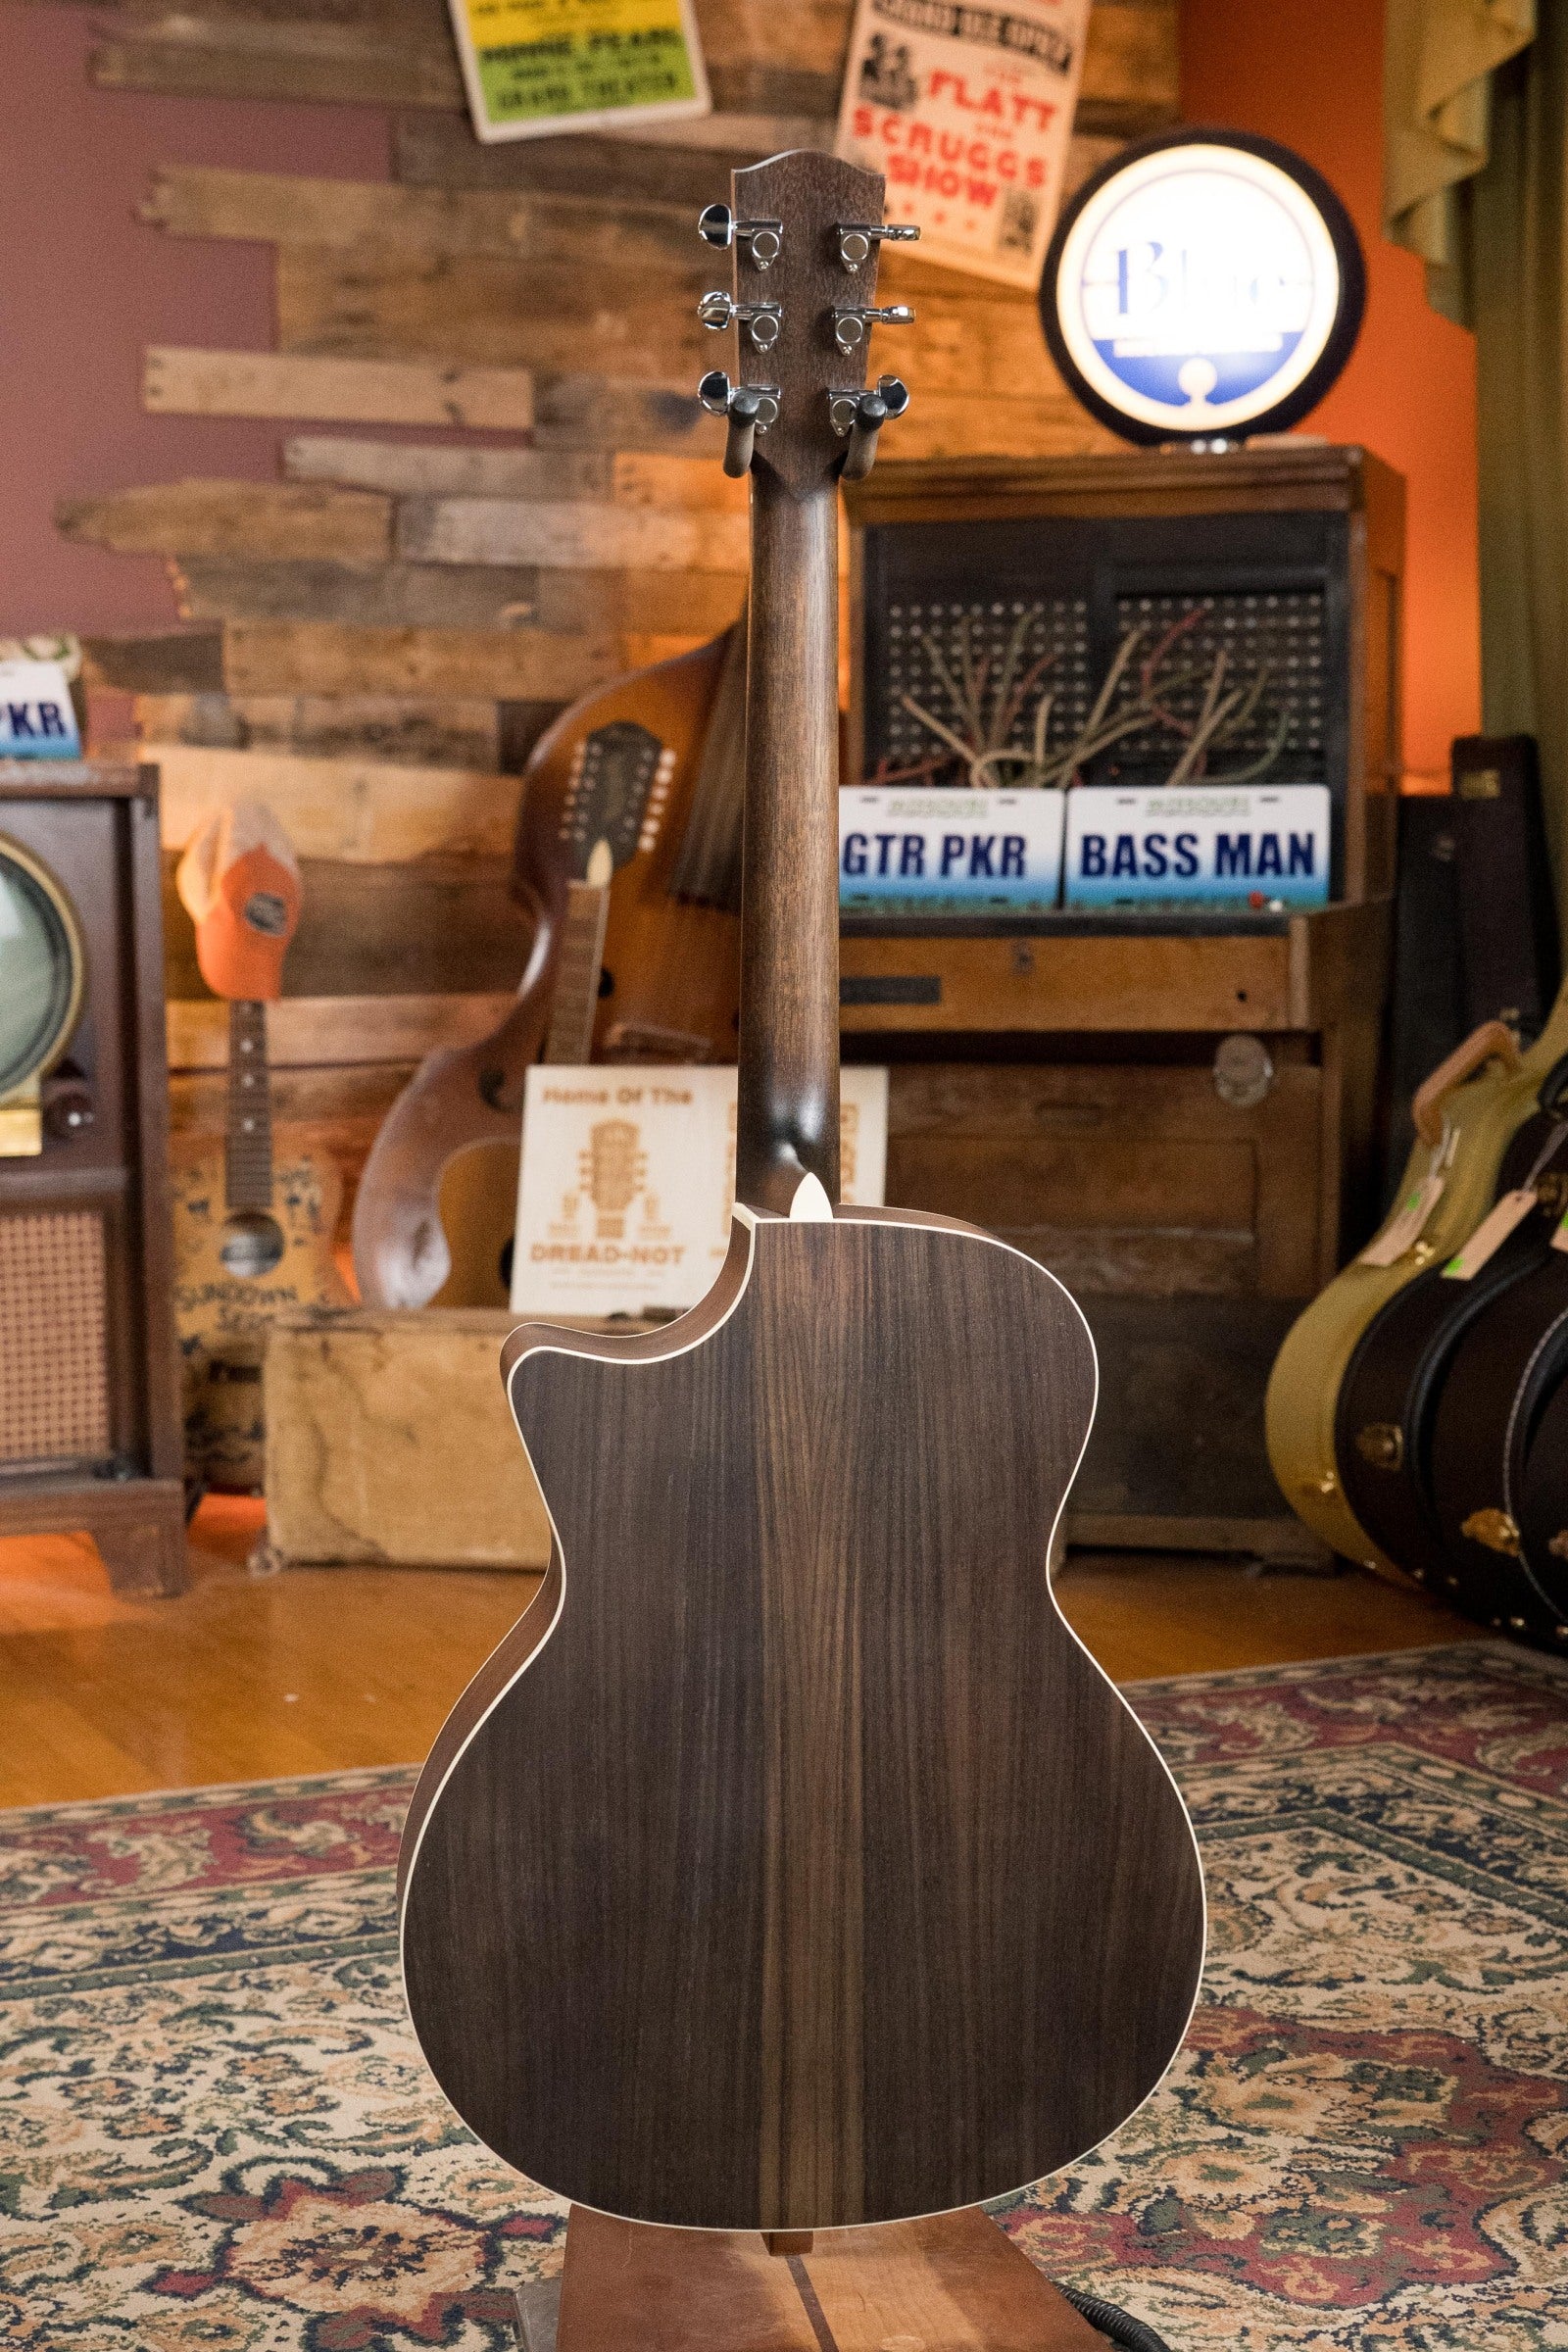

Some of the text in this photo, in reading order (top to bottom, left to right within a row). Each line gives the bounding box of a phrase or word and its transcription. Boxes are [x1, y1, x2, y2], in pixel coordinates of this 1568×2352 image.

[928, 67, 1056, 134] FLATT
[852, 104, 1047, 191] SCRUGGS
[887, 153, 1000, 211] SHOW
[1117, 239, 1288, 317] Ble
[0, 702, 67, 738] KR
[841, 832, 1027, 878] GTR PKR
[1081, 831, 1317, 879] BASS MAN
[651, 1086, 694, 1105] The
[530, 1243, 686, 1265] DREAD-NOT
